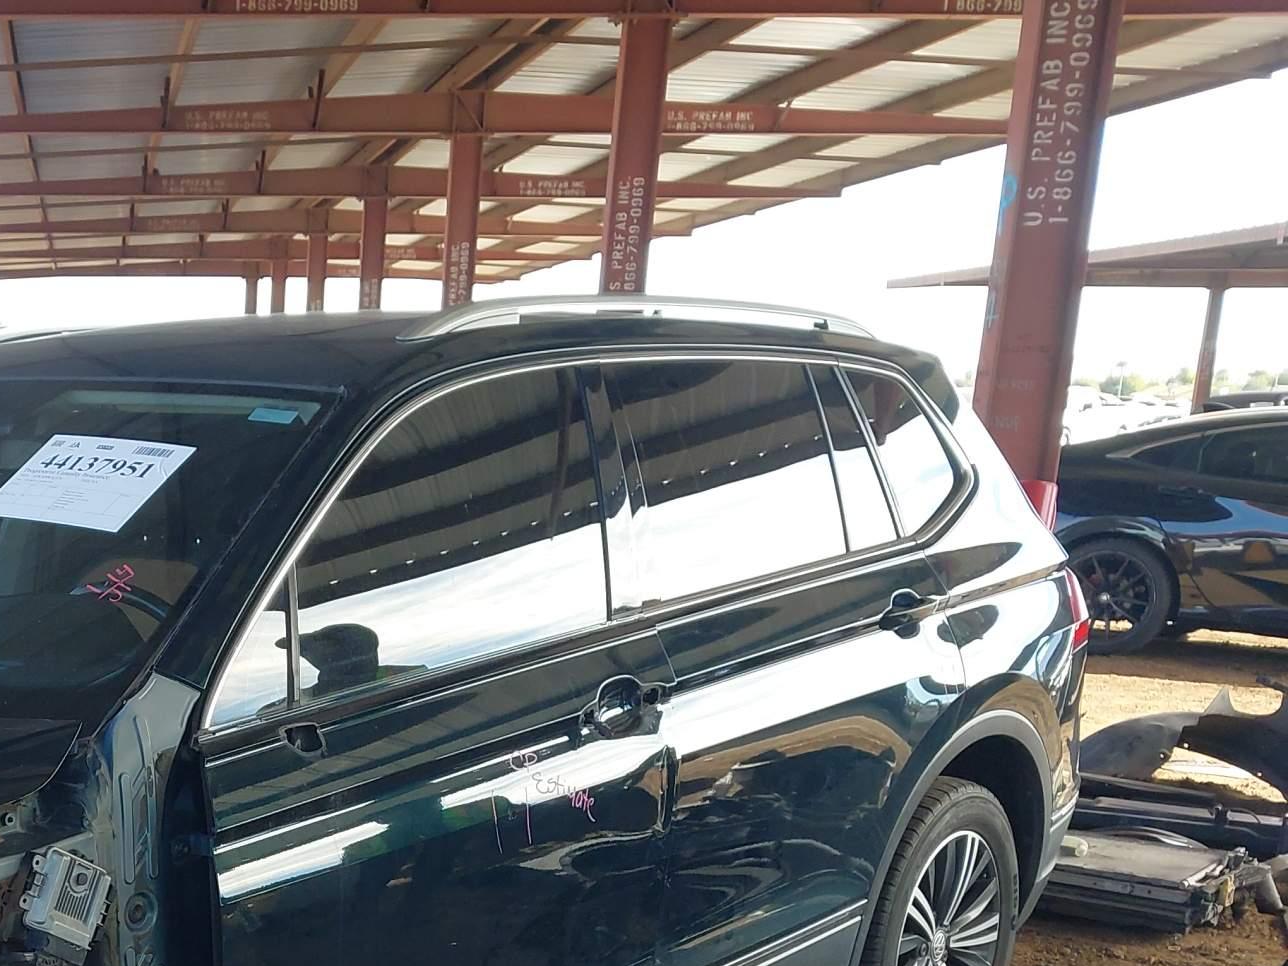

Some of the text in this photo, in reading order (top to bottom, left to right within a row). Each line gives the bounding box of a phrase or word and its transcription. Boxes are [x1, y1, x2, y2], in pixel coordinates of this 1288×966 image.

[1031, 59, 1062, 161] PREFAB
[1023, 178, 1050, 226] U.S.
[611, 211, 629, 270] PREFAB
[40, 453, 155, 479] 44137951
